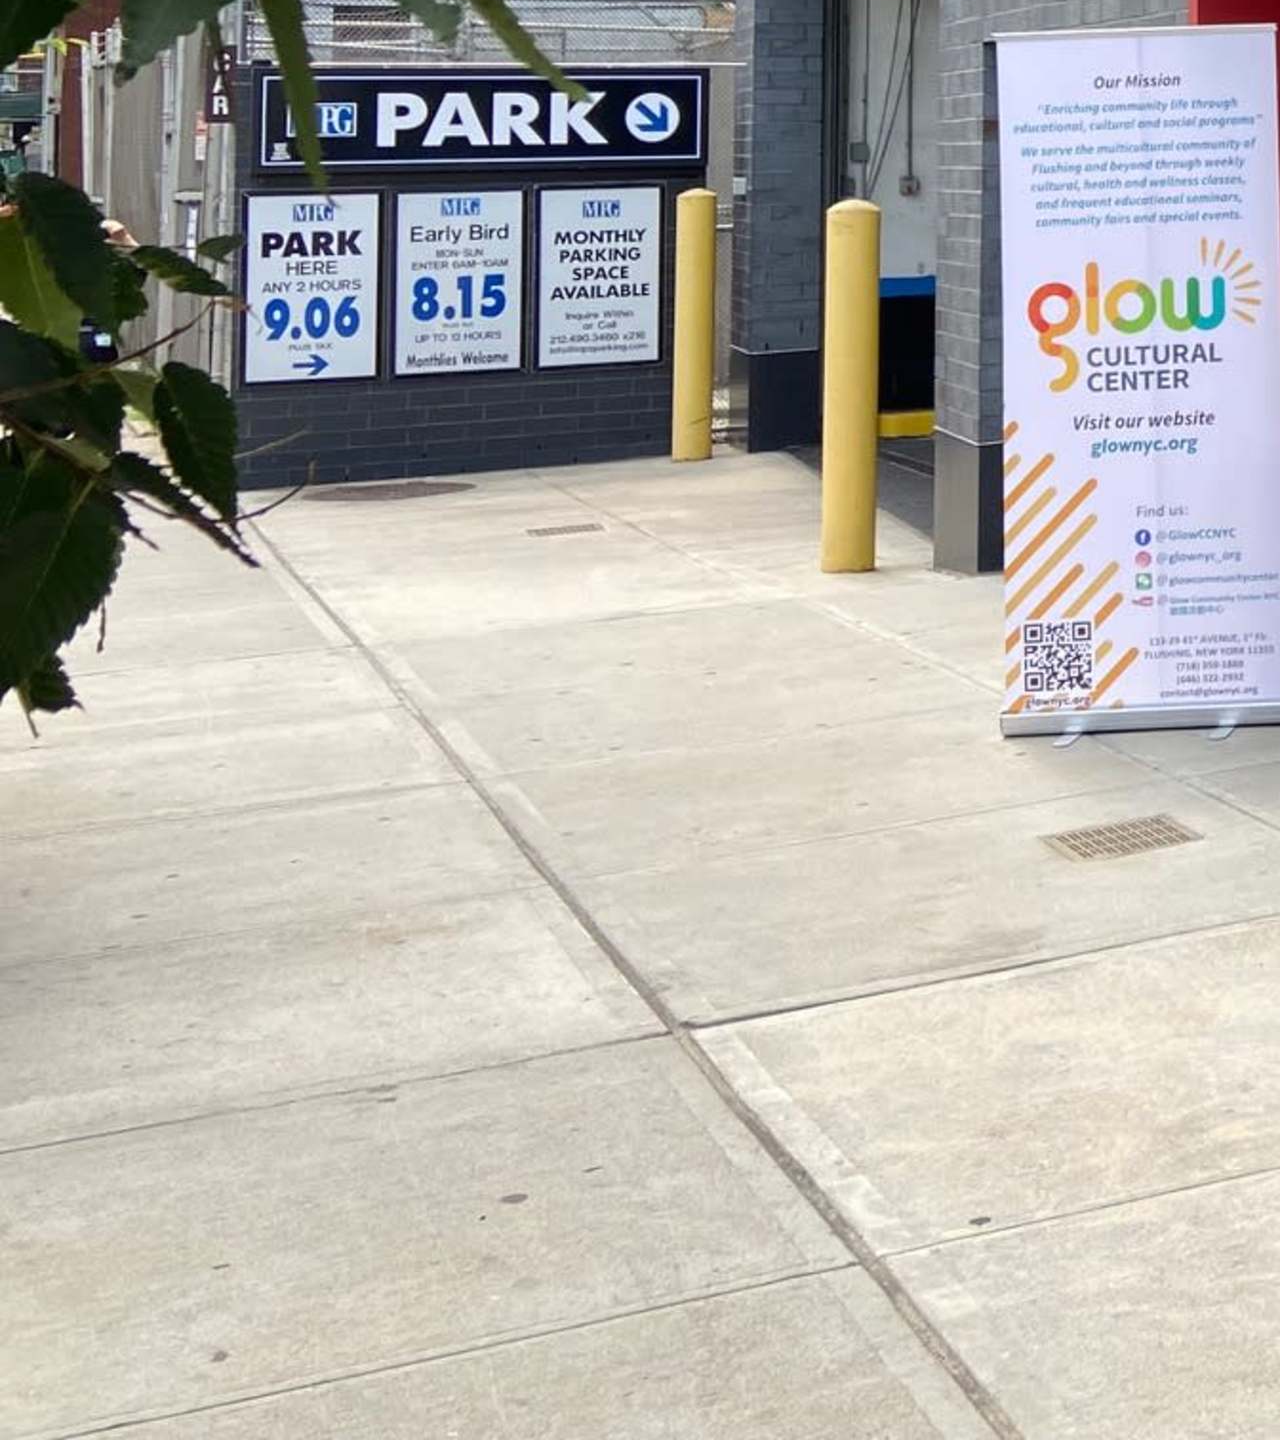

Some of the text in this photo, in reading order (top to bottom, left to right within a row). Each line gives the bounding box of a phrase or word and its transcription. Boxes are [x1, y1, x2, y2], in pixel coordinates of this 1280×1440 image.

[1094, 73, 1181, 89] Our Mission
[1102, 100, 1168, 113] community
[1170, 98, 1188, 110] life
[1191, 97, 1238, 110] through
[376, 92, 609, 147] PARK
[1089, 118, 1136, 131] cultural
[1138, 118, 1160, 128] and
[1163, 116, 1197, 128] social
[1021, 137, 1256, 157] We serve the multicultural community of
[1032, 156, 1246, 175] Flushing and beyond through weekly
[1083, 178, 1122, 190] health
[1124, 177, 1147, 188] and
[1150, 175, 1199, 187] wellness
[1035, 199, 1059, 210] and
[1061, 197, 1112, 209] frequent
[1114, 194, 1184, 206] educational
[1035, 216, 1102, 228] community
[1104, 213, 1131, 225] fairs
[1133, 212, 1157, 224] and
[1159, 210, 1200, 224] special
[410, 223, 509, 244] Early Bird
[554, 229, 647, 244] MONTHLY
[261, 230, 362, 258] PARK
[559, 247, 641, 263] PARKING
[286, 260, 338, 276] HERE
[411, 261, 448, 271] ENTER
[572, 266, 629, 281] SPACE
[262, 279, 362, 293] ANY 2 HOURS
[550, 283, 650, 300] AVAILABLE
[412, 274, 507, 321] 8.15
[264, 296, 361, 341] 9.06
[464, 331, 502, 340] HOURS
[1027, 262, 1226, 393] glow
[1086, 343, 1223, 368] CULTURAL
[1086, 368, 1189, 392] CENTER
[1073, 410, 1216, 431] Visit our website
[1091, 437, 1198, 458] glownyc.org
[1136, 505, 1165, 517] Find
[1196, 647, 1218, 657] NEW
